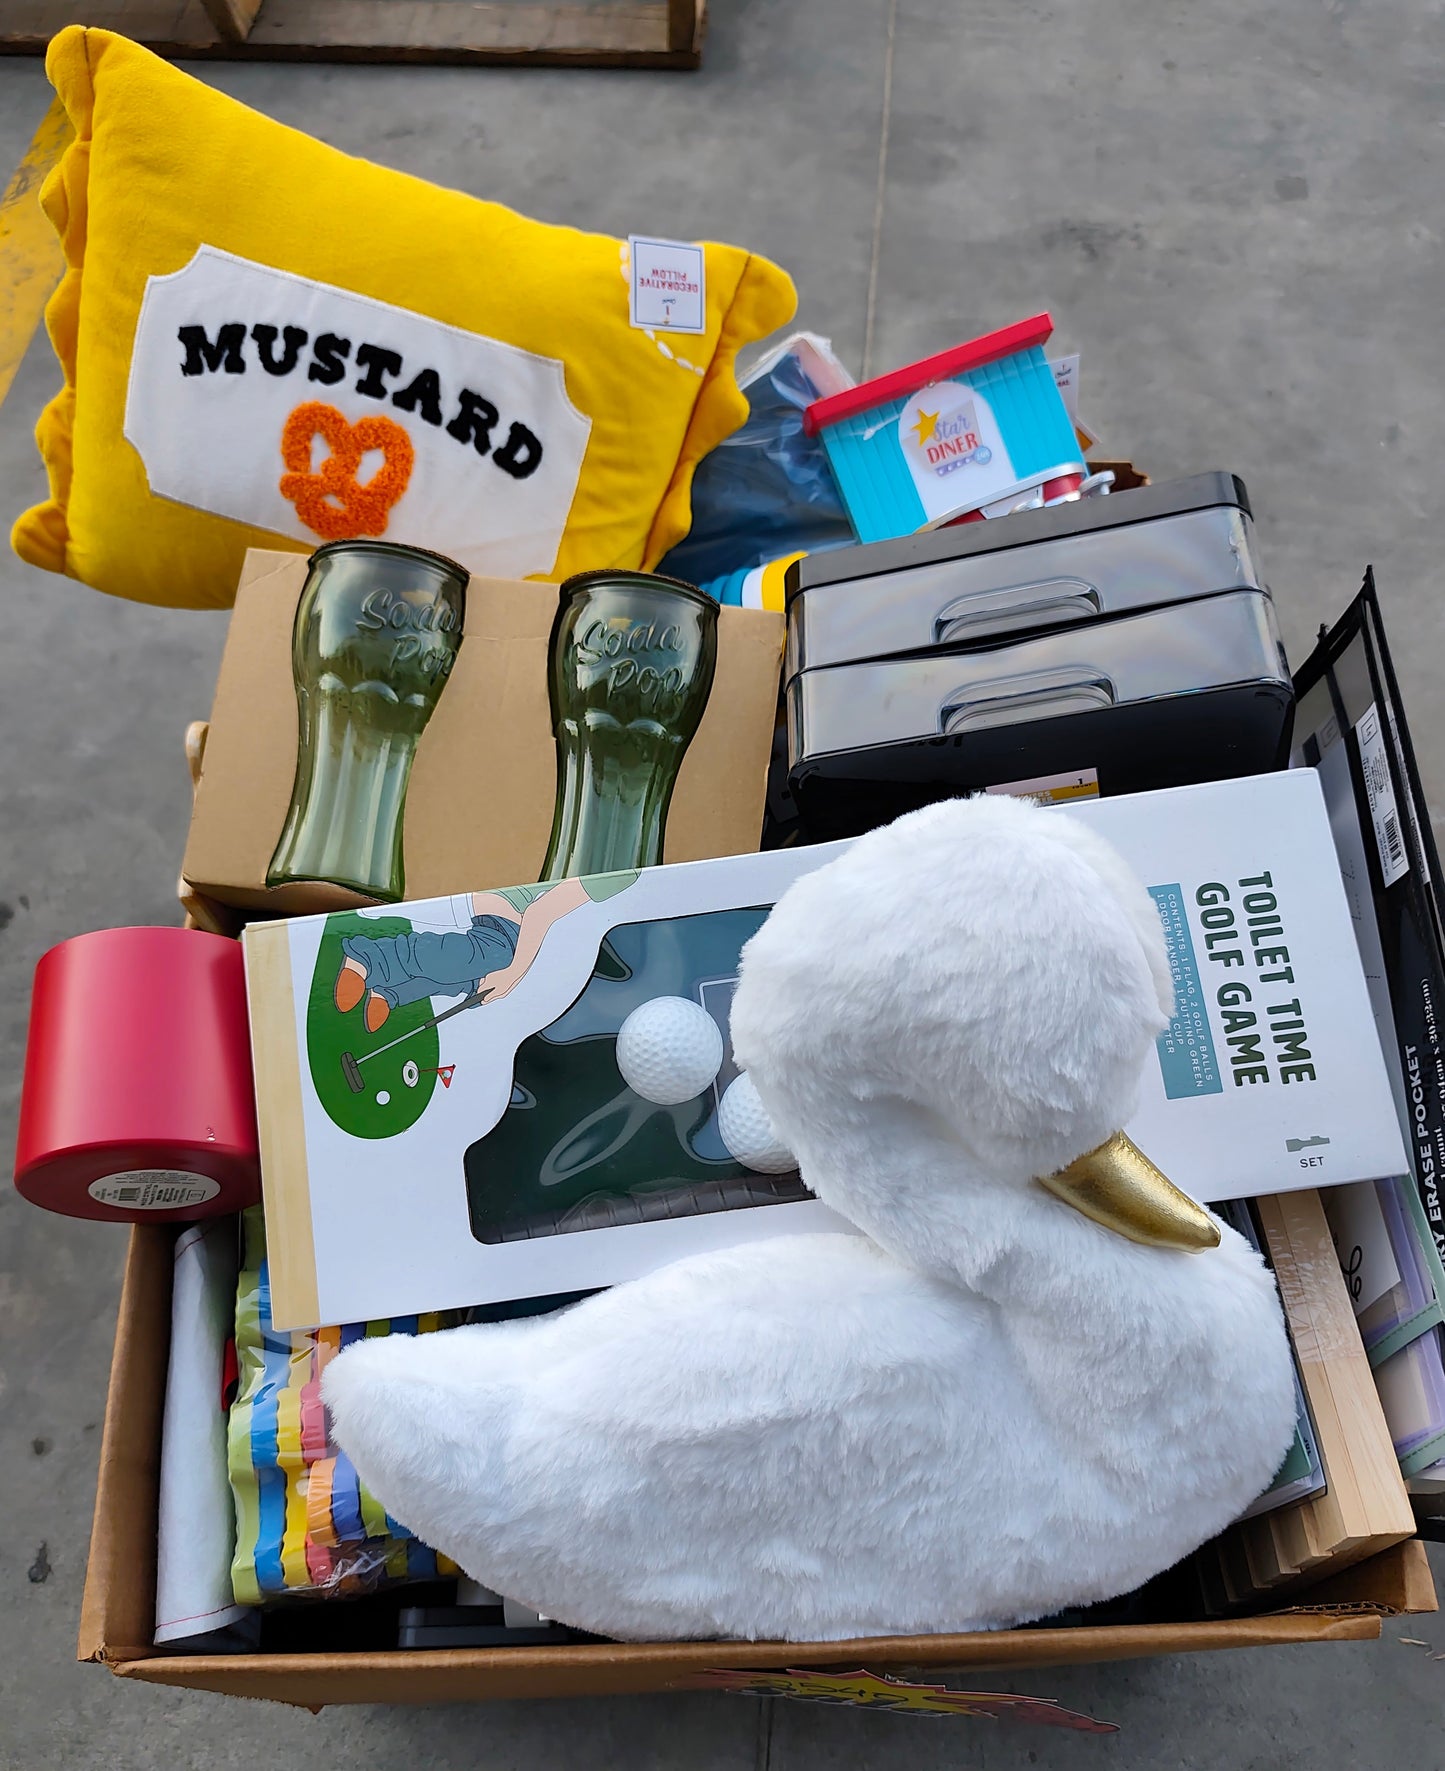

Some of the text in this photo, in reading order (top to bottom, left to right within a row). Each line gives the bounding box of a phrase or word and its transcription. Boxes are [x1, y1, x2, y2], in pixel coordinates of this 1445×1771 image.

[639, 277, 699, 294] DECORATIVE
[651, 268, 687, 282] PILLOW
[178, 323, 543, 479] MUSTARD
[926, 432, 979, 465] DINER
[934, 414, 970, 442] Star
[355, 586, 462, 633] Soda
[389, 633, 458, 686] Pop
[576, 617, 686, 666] Soda
[607, 658, 688, 714] Pop
[1159, 902, 1172, 932] DOOR
[1179, 998, 1195, 1046] PUTTING
[1189, 1049, 1204, 1088] GREEN
[1168, 893, 1186, 953] CONTENTS:
[1184, 966, 1195, 997] FLAG,
[1193, 1011, 1205, 1041] GOLF
[1199, 1045, 1213, 1081] BALLS
[1195, 882, 1270, 1087] GOLF GAME
[1238, 870, 1317, 1085] TOILET TIME
[1173, 1022, 1184, 1045] CUP
[1433, 1046, 1440, 1055] x
[1405, 1045, 1430, 1138] POCKET
[1299, 1156, 1324, 1168] SET
[1419, 1143, 1442, 1222] ERASE
